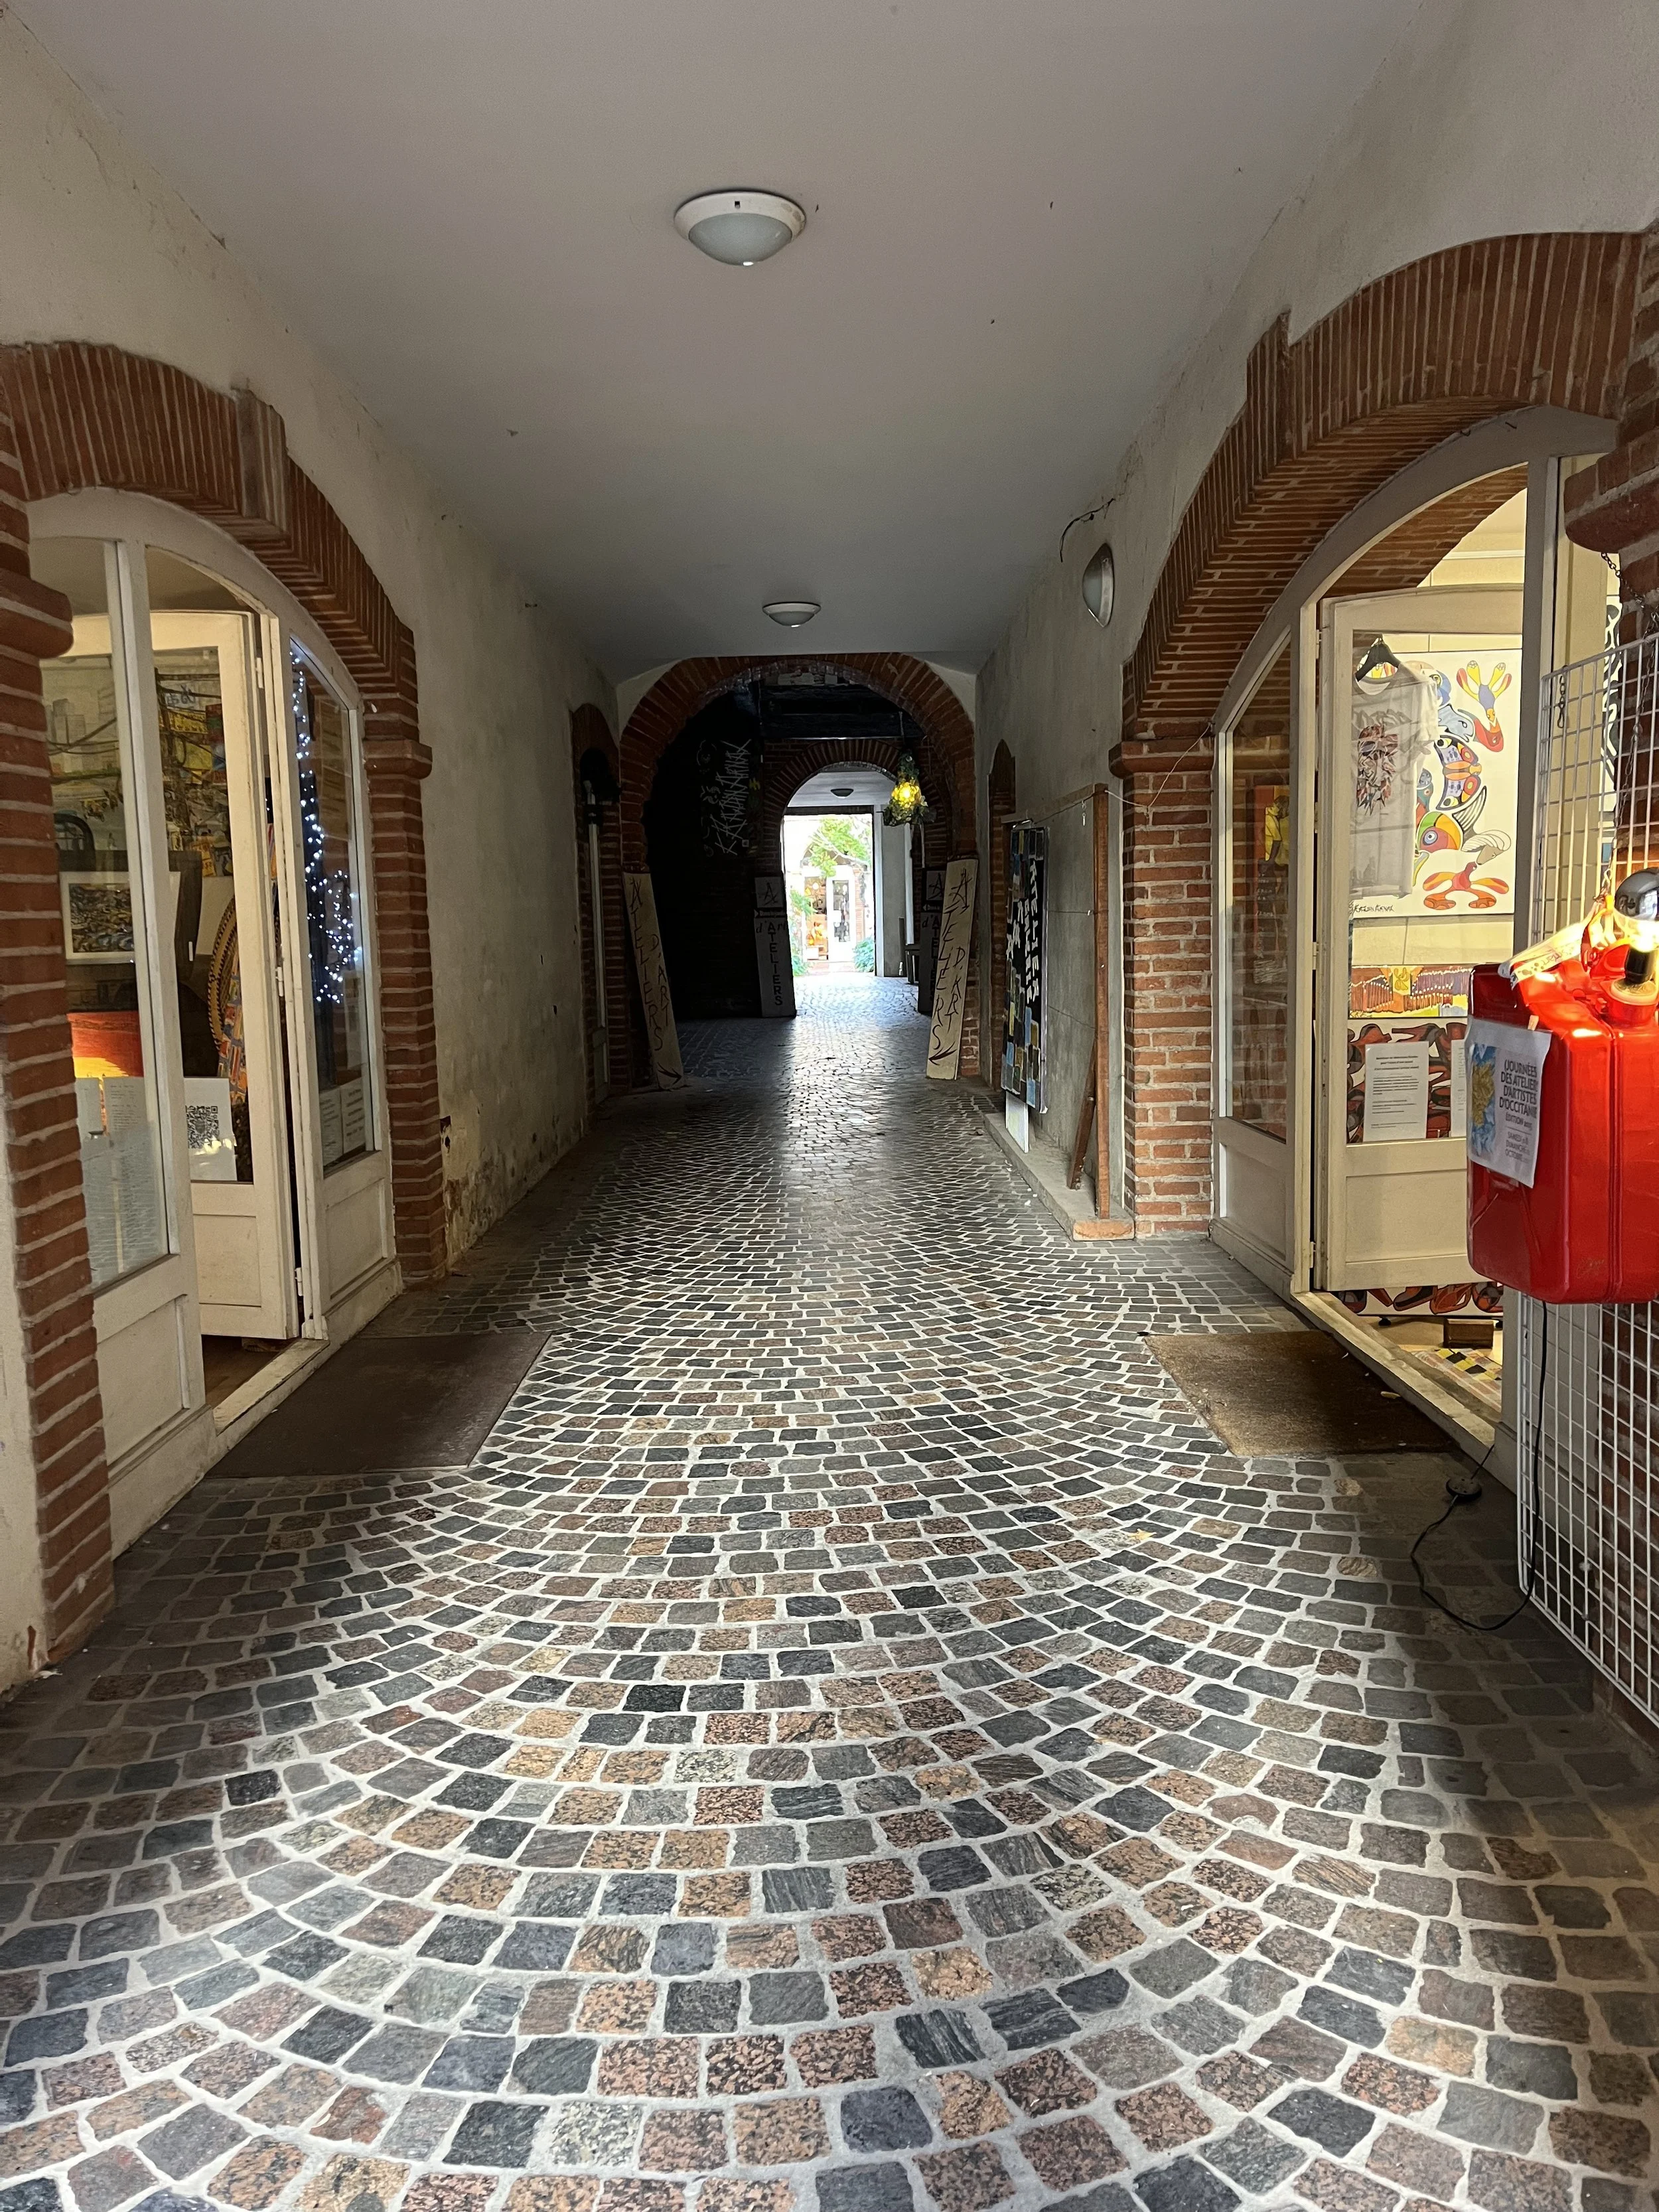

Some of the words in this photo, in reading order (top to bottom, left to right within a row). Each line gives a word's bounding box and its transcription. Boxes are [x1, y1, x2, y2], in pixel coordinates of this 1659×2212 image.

[630, 876, 663, 1052] ATELIERS
[768, 921, 783, 1006] ATELIERS
[1501, 1071, 1512, 1084] DES
